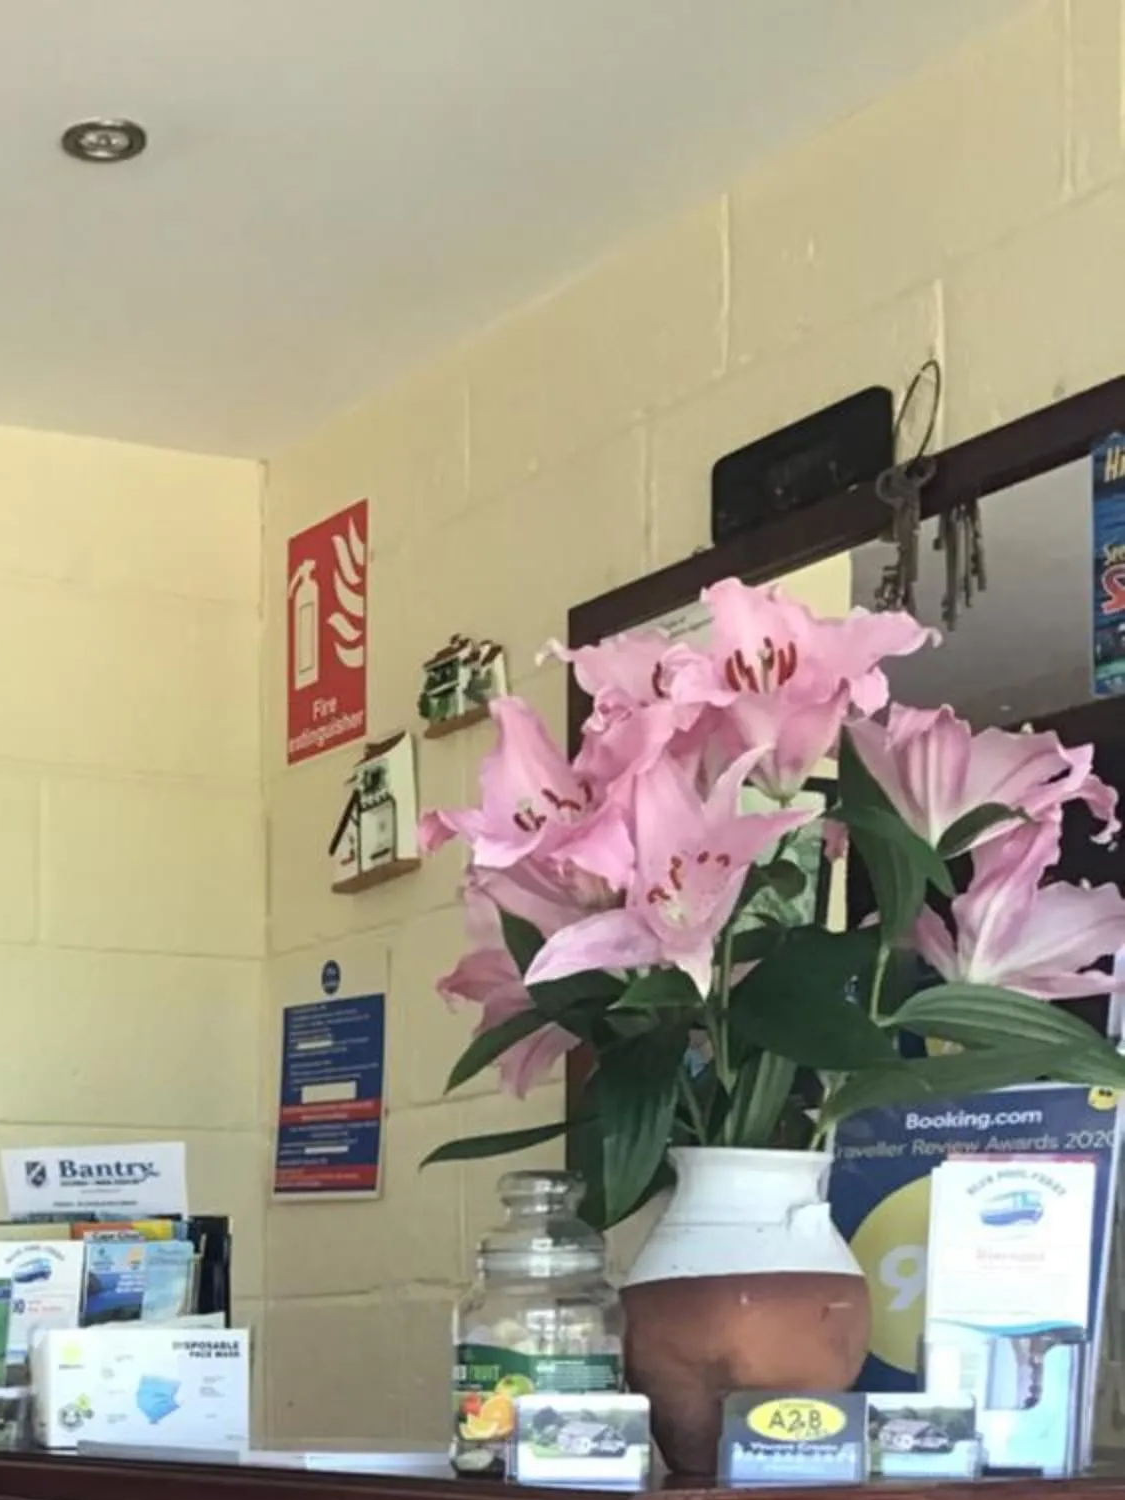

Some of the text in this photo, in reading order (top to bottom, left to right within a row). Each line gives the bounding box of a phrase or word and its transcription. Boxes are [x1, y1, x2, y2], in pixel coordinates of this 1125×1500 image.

[905, 1108, 1044, 1132] Booking.com
[836, 1141, 906, 1159] raveller
[912, 1135, 981, 1154] Review
[987, 1133, 1059, 1151] Awards
[58, 1160, 161, 1183] Bantry
